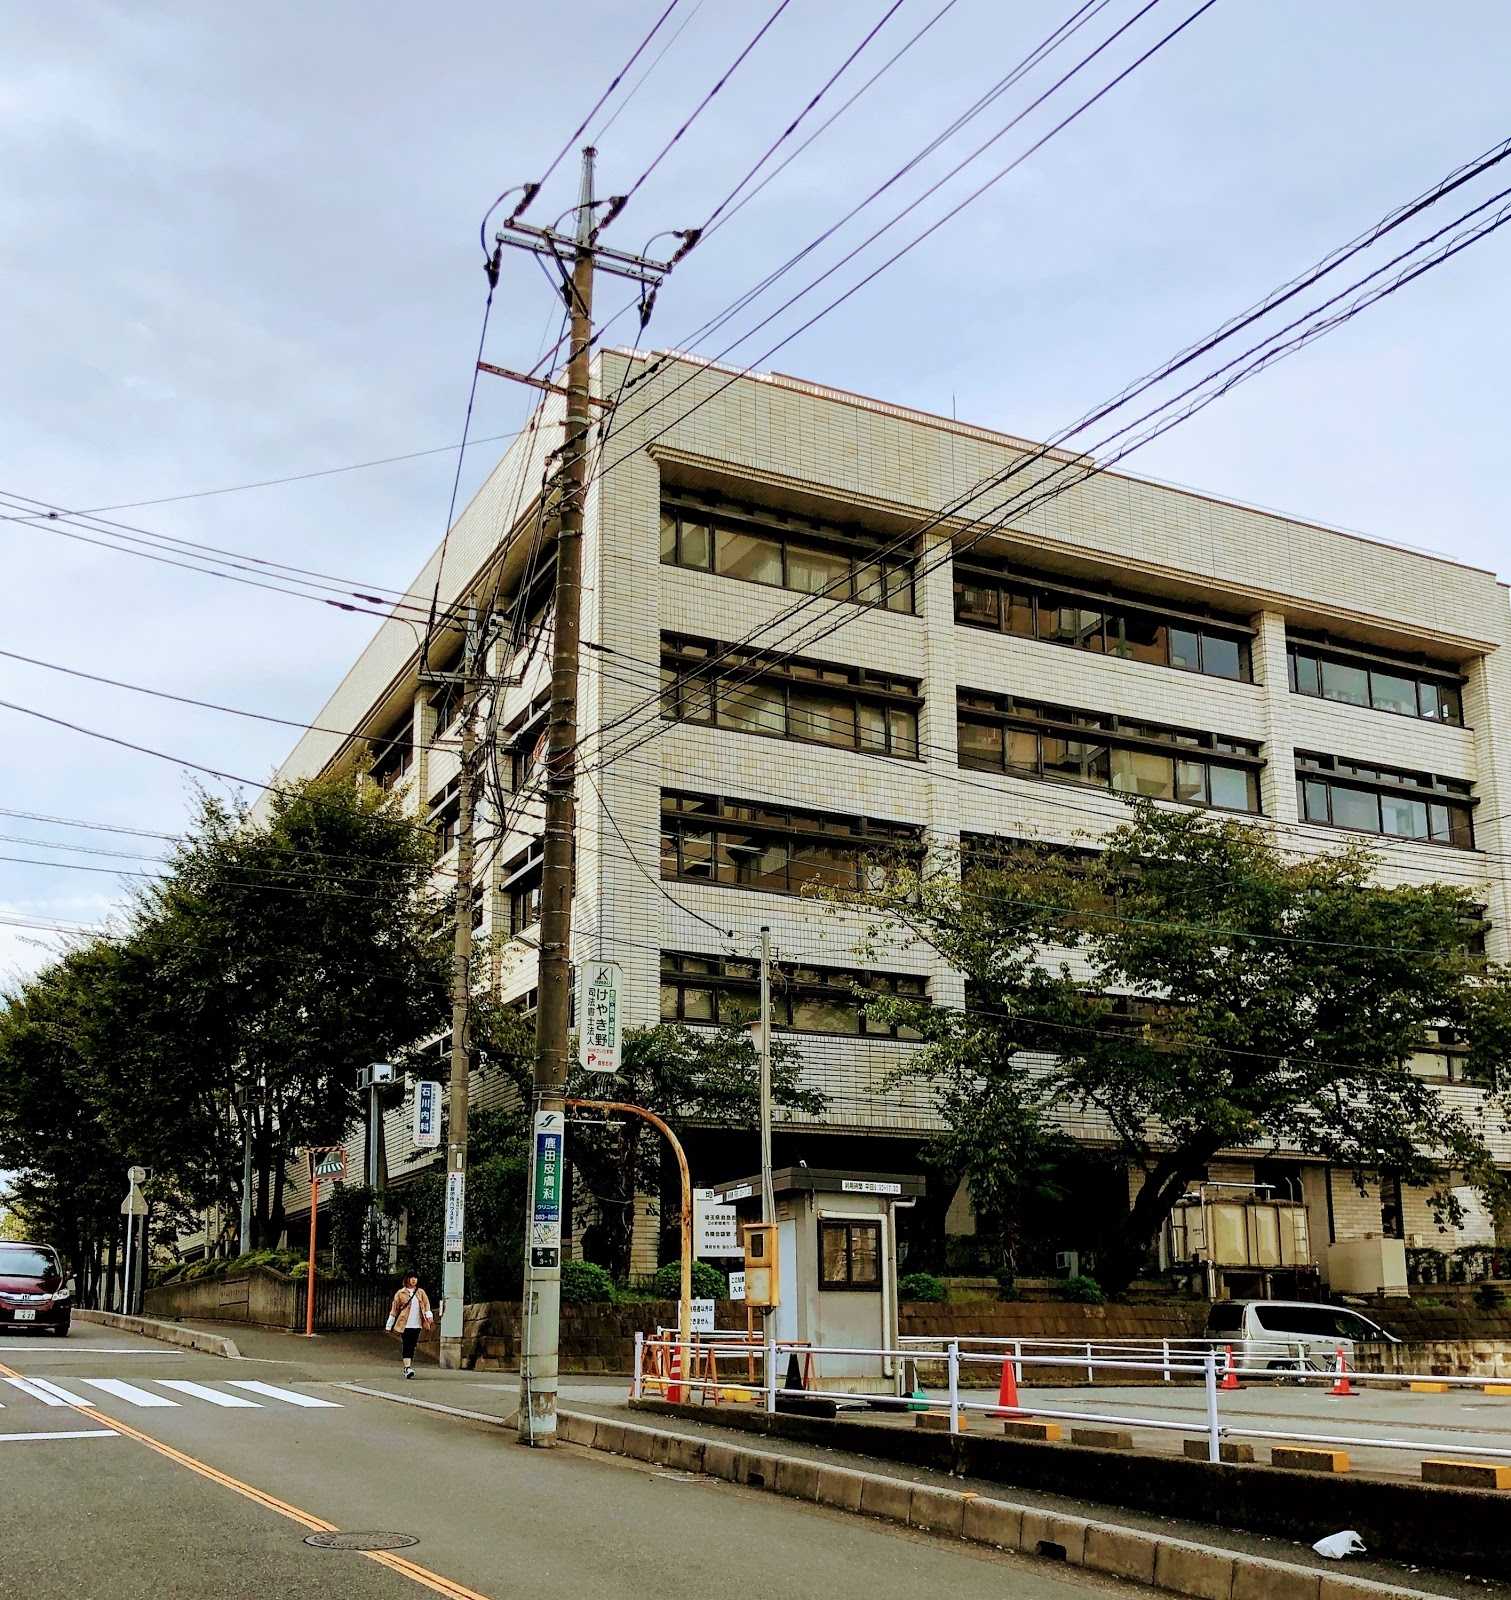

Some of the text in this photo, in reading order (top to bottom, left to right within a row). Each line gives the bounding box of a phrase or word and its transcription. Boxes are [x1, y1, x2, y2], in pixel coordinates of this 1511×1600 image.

[586, 987, 596, 1046] 司法書士法人
[595, 988, 609, 1047] けやき野
[420, 1087, 432, 1133] 石川内科
